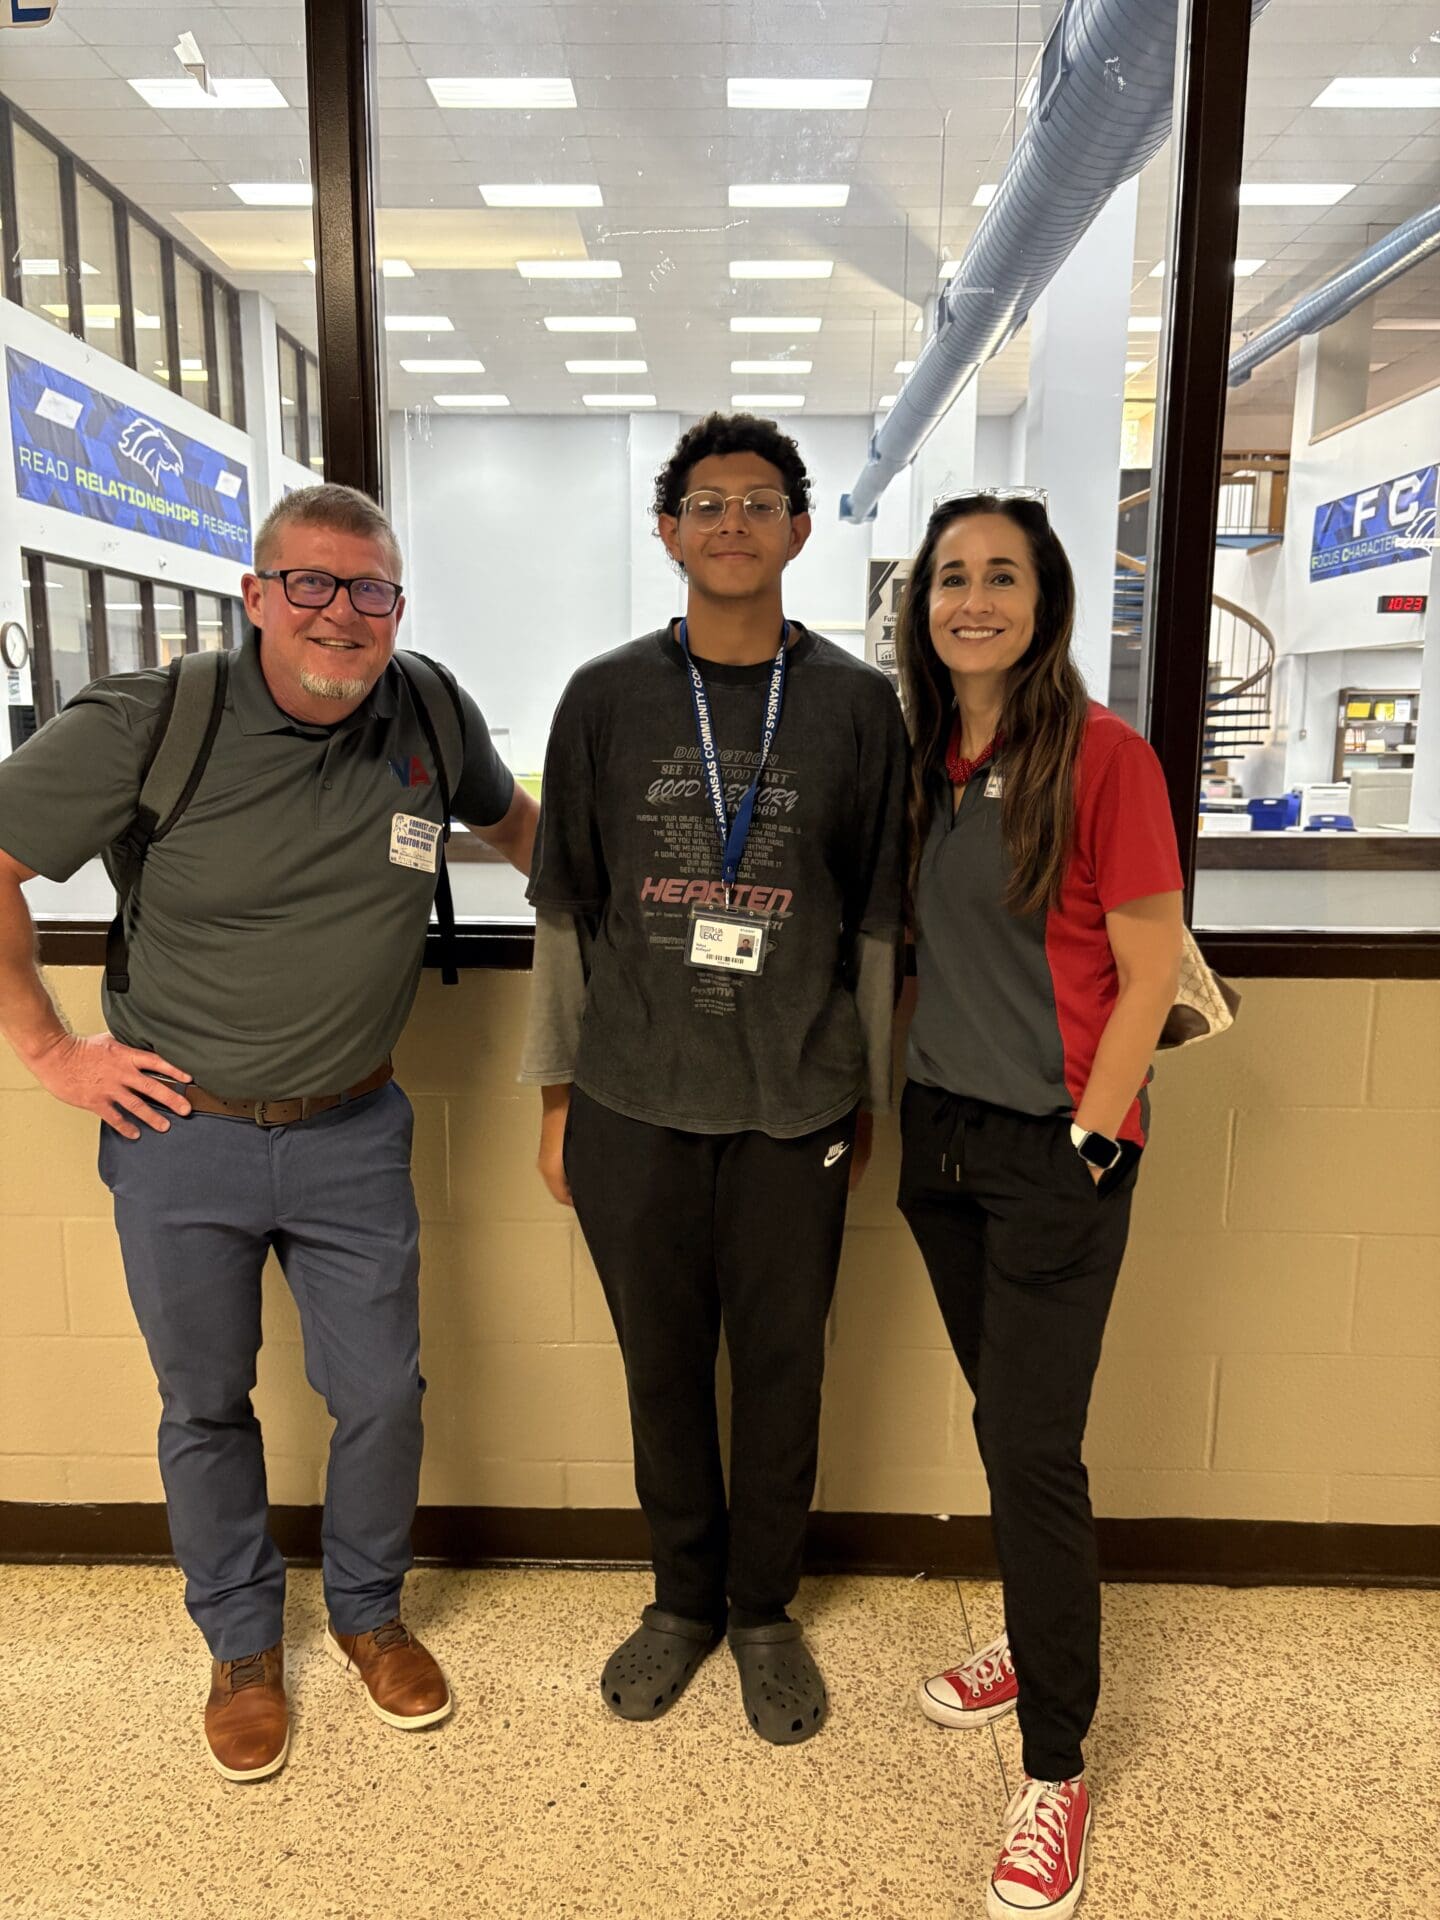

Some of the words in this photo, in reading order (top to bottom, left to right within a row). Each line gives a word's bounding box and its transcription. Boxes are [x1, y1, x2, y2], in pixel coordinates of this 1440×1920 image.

[19, 446, 69, 482] READ
[75, 466, 199, 527] RELATIONSHIPS
[203, 513, 249, 544] RESPECT
[1311, 550, 1340, 570] FOCUS
[766, 668, 782, 729] ARKANSAS
[695, 690, 714, 759] COMMUNITY
[661, 764, 684, 776] SEE
[720, 767, 751, 780] OOD
[755, 771, 790, 785] ART
[647, 778, 701, 803] GOOD
[705, 783, 800, 814] EORY
[707, 760, 727, 824] ARKANSAS
[752, 803, 778, 817] 989
[396, 835, 420, 849] VISITOR
[703, 931, 724, 942] EACC
